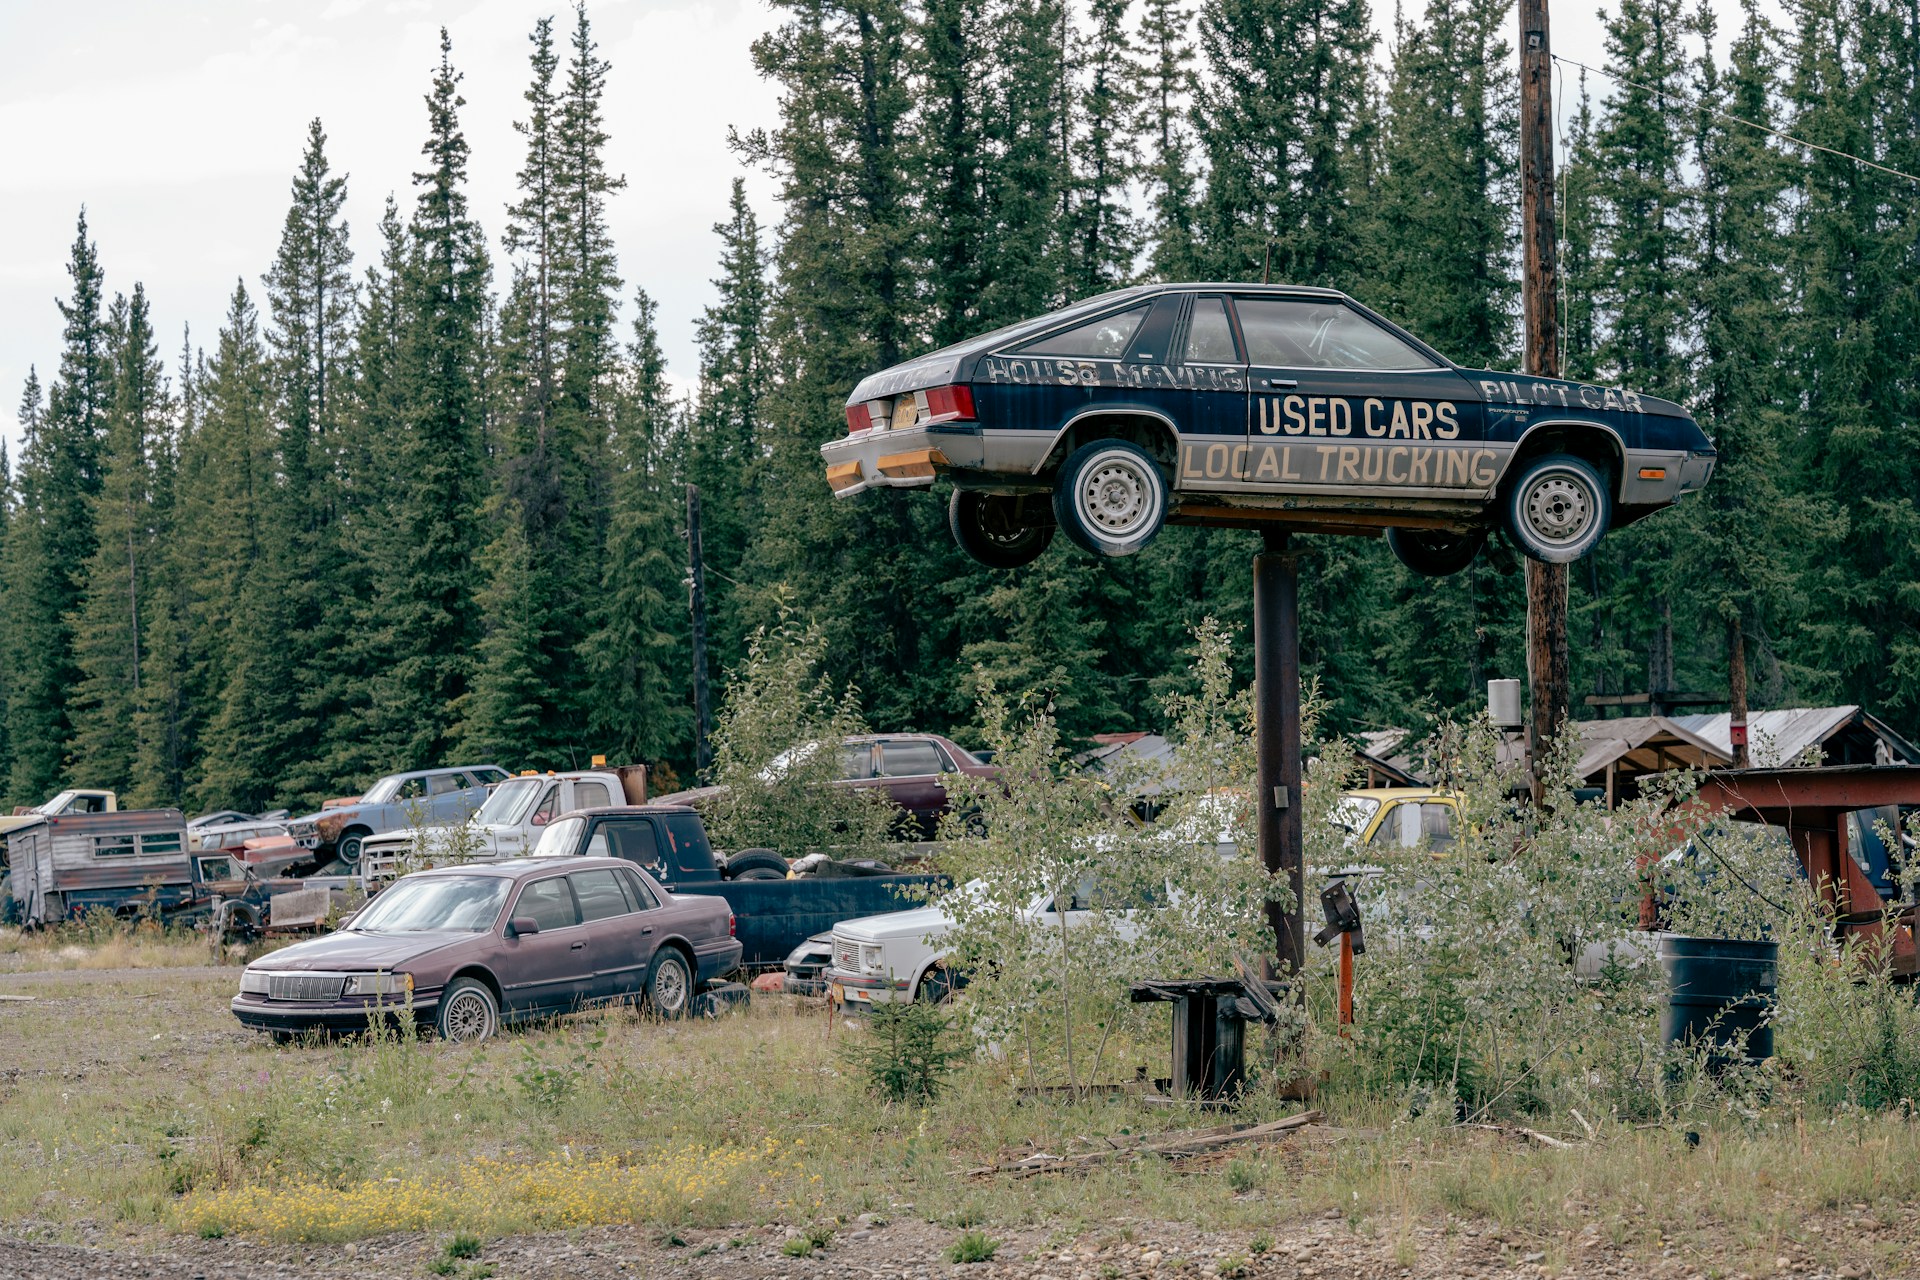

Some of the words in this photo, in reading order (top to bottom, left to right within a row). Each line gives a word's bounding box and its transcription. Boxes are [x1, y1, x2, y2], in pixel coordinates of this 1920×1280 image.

[986, 359, 1101, 386] HOUSE
[1479, 380, 1569, 407] PILOT
[1578, 384, 1647, 414] CAR
[1259, 395, 1352, 436] USED
[1364, 398, 1460, 440] CARS
[1183, 443, 1300, 479] LOCAL
[1316, 446, 1497, 486] TRUCKING
